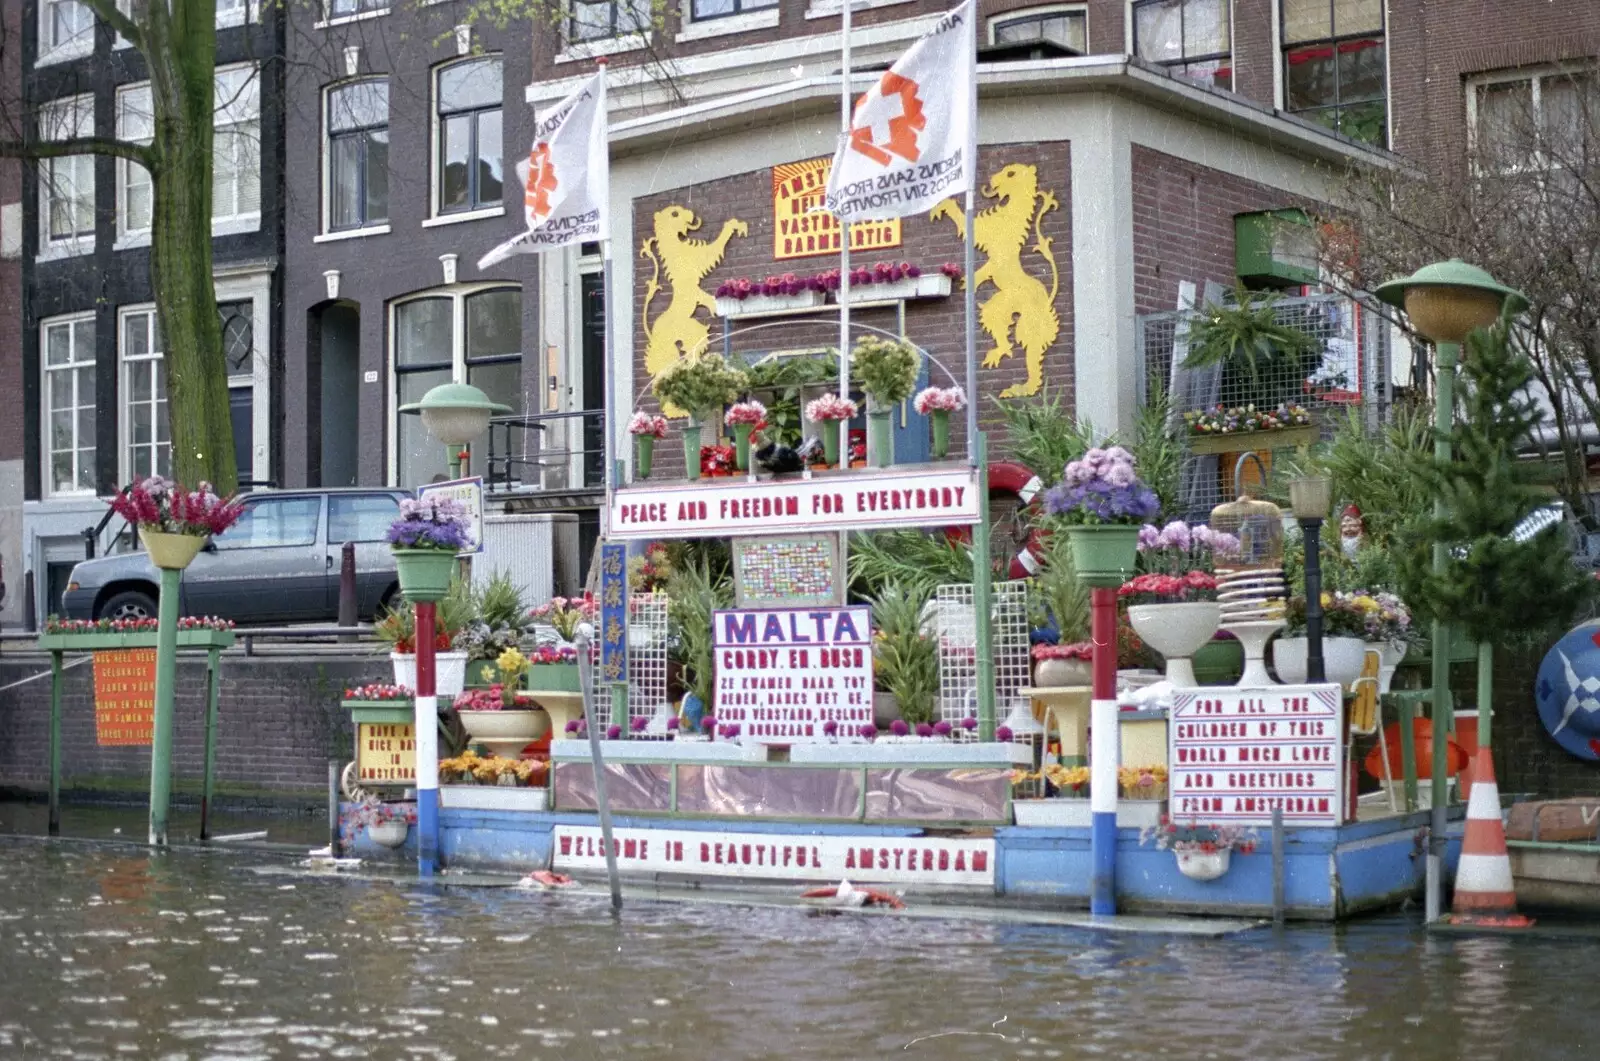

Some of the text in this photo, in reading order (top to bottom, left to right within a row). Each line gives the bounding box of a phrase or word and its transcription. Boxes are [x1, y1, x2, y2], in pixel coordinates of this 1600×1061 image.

[621, 486, 965, 523] PEACE AND FREEDOM FOR EVERYBODY
[724, 612, 860, 643] MALTA
[820, 648, 864, 668] BUSH
[721, 676, 866, 689] ZE KWAMEN DAAR TOT
[1196, 698, 1309, 713] FOR ALL THE
[718, 708, 746, 721] ZOND
[370, 726, 410, 737] HAVE A
[749, 723, 814, 737] DUURZAAM
[1177, 721, 1324, 738] CHILDREN OF THIS
[369, 740, 392, 751] NICE
[391, 754, 400, 765] IN
[1177, 747, 1330, 762] WORLD MUCH LOVE
[1185, 773, 1314, 787] AND GREETINGS
[1182, 798, 1329, 812] FROM AMSTERDAM
[665, 840, 684, 861] IN
[700, 842, 822, 868] BEAUTIFUL
[845, 847, 988, 872] AMSTERDAM
